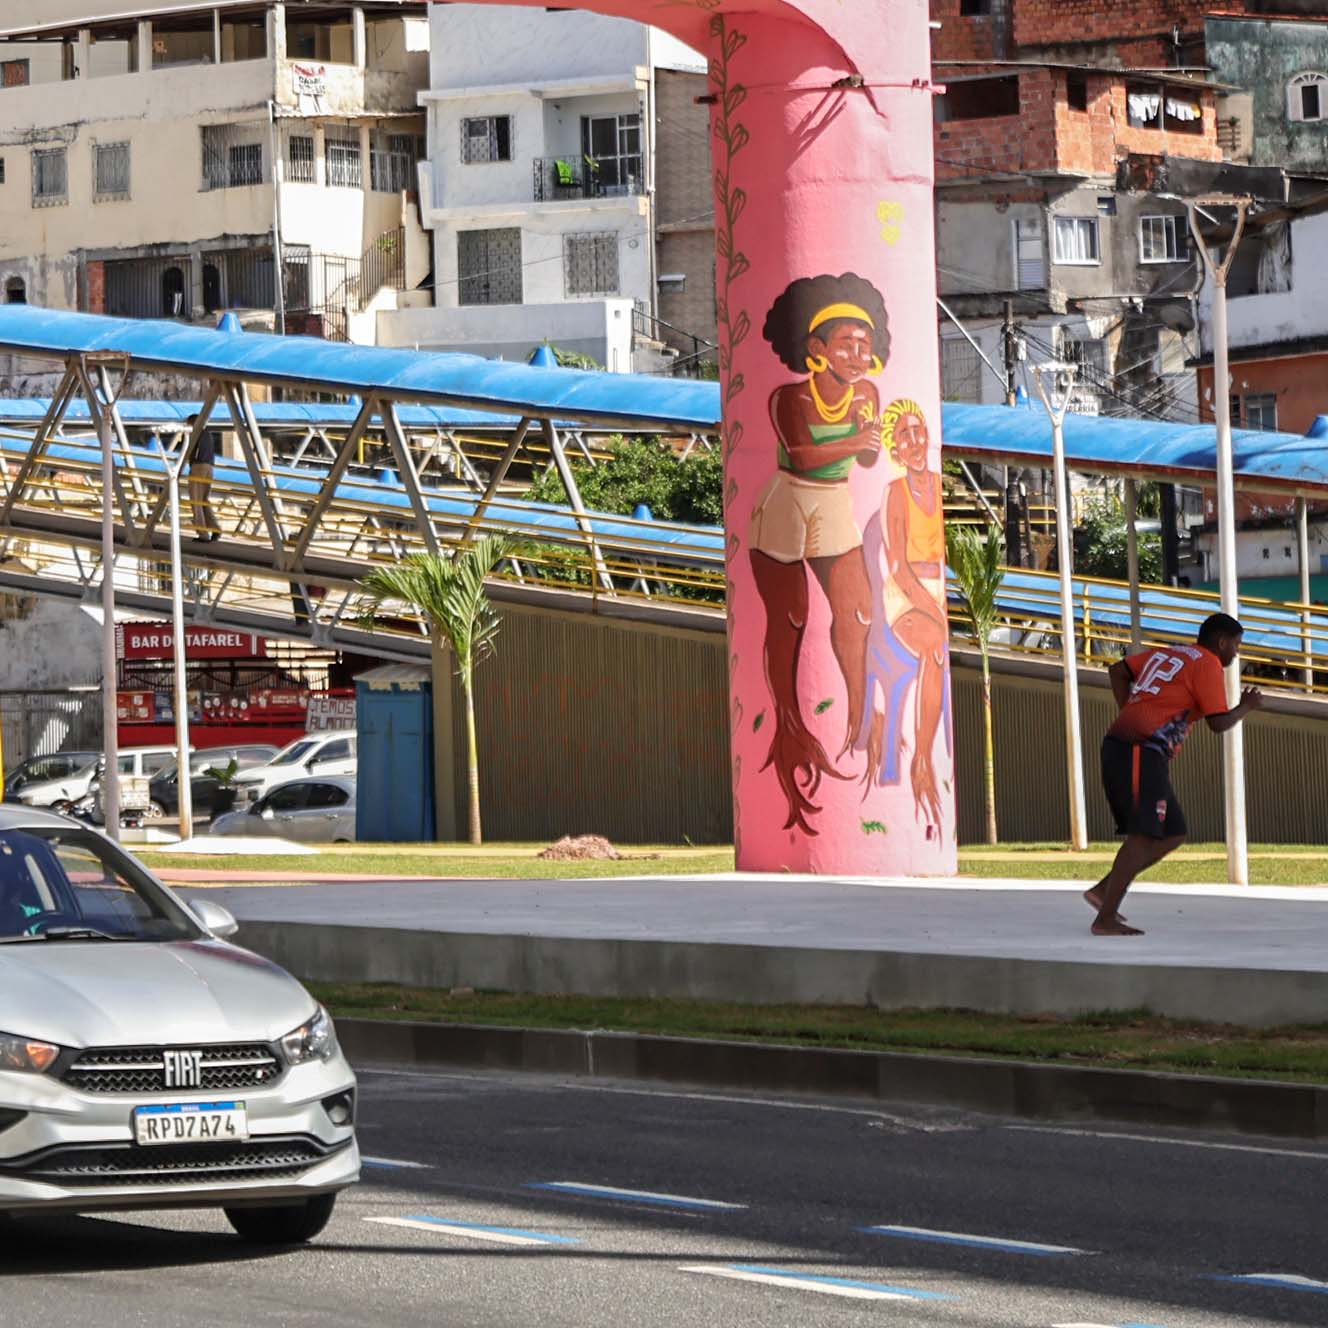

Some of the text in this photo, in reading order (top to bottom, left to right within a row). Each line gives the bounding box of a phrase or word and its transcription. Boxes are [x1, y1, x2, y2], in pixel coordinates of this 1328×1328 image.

[131, 636, 159, 648] BAR
[185, 634, 243, 647] TAFAREL
[163, 1050, 203, 1087] FIAT
[147, 1115, 236, 1140] RPD7A74
